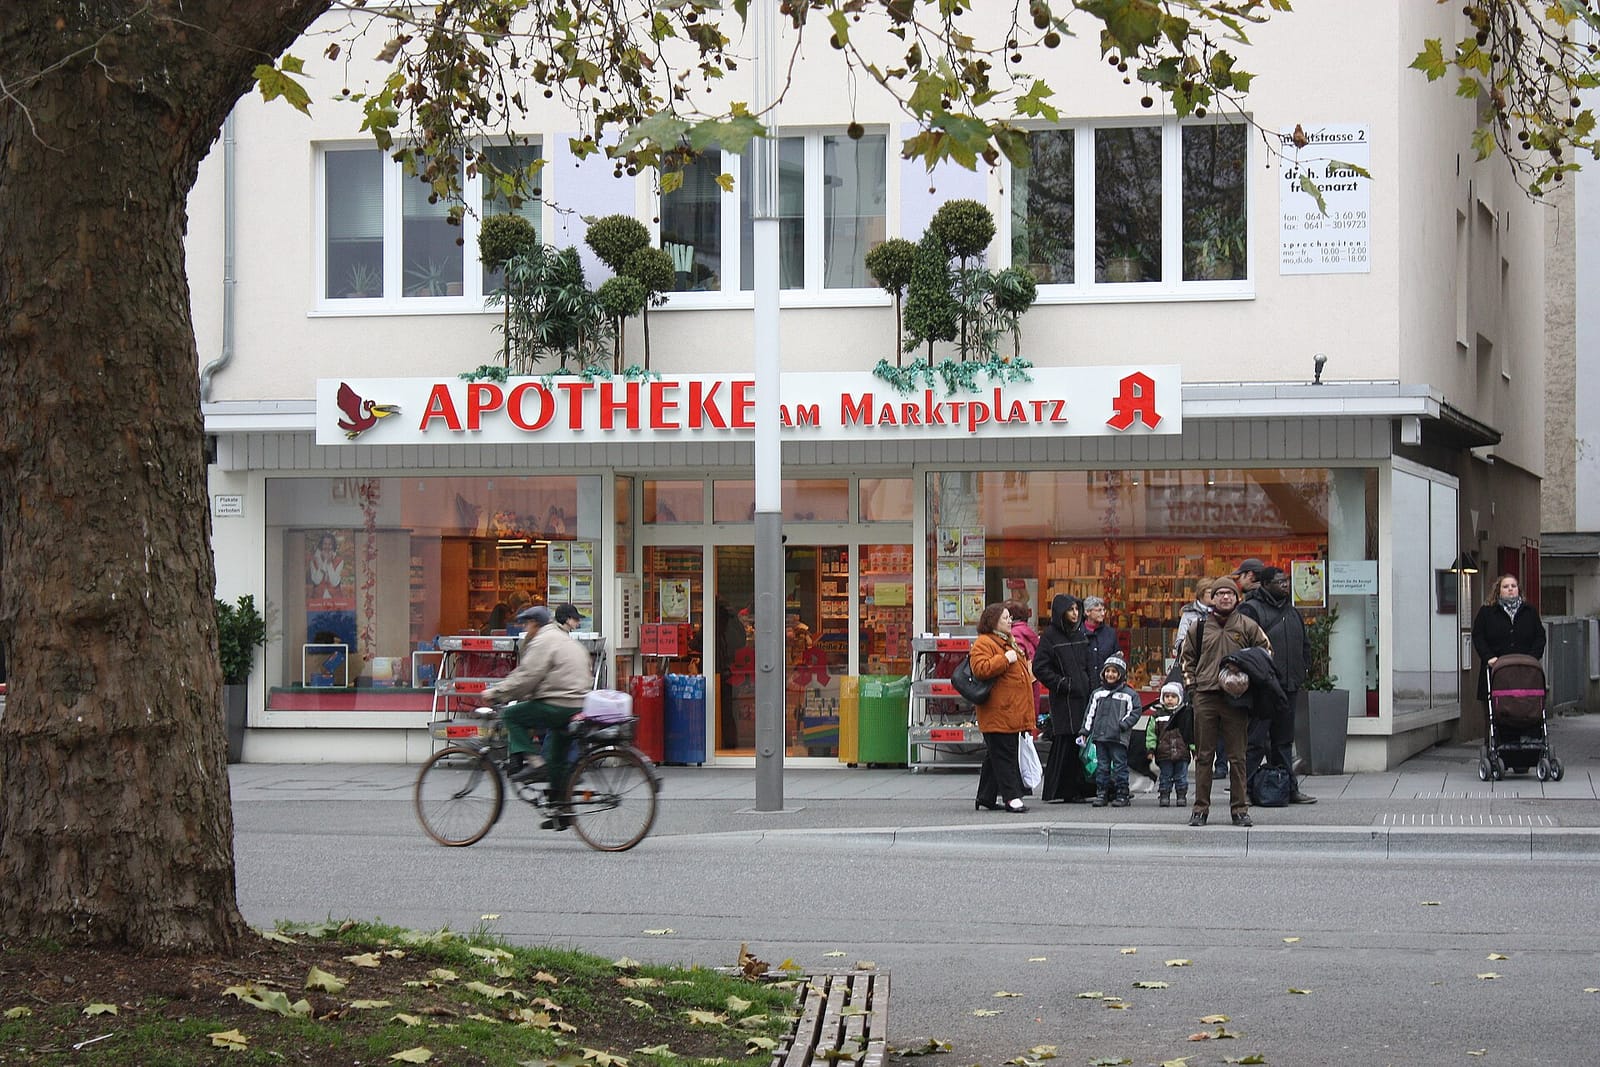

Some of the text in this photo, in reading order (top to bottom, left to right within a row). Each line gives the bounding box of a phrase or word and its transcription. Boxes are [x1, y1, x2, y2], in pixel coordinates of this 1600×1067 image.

[1283, 129, 1366, 143] mktstrasse 2
[1307, 167, 1319, 179] h.
[1290, 182, 1358, 193] frenarzt
[1305, 212, 1325, 221] 0641
[1304, 221, 1323, 230] 0641
[419, 381, 756, 432] APOTHEKE
[779, 402, 821, 428] AM
[1154, 543, 1182, 555] VICHY
